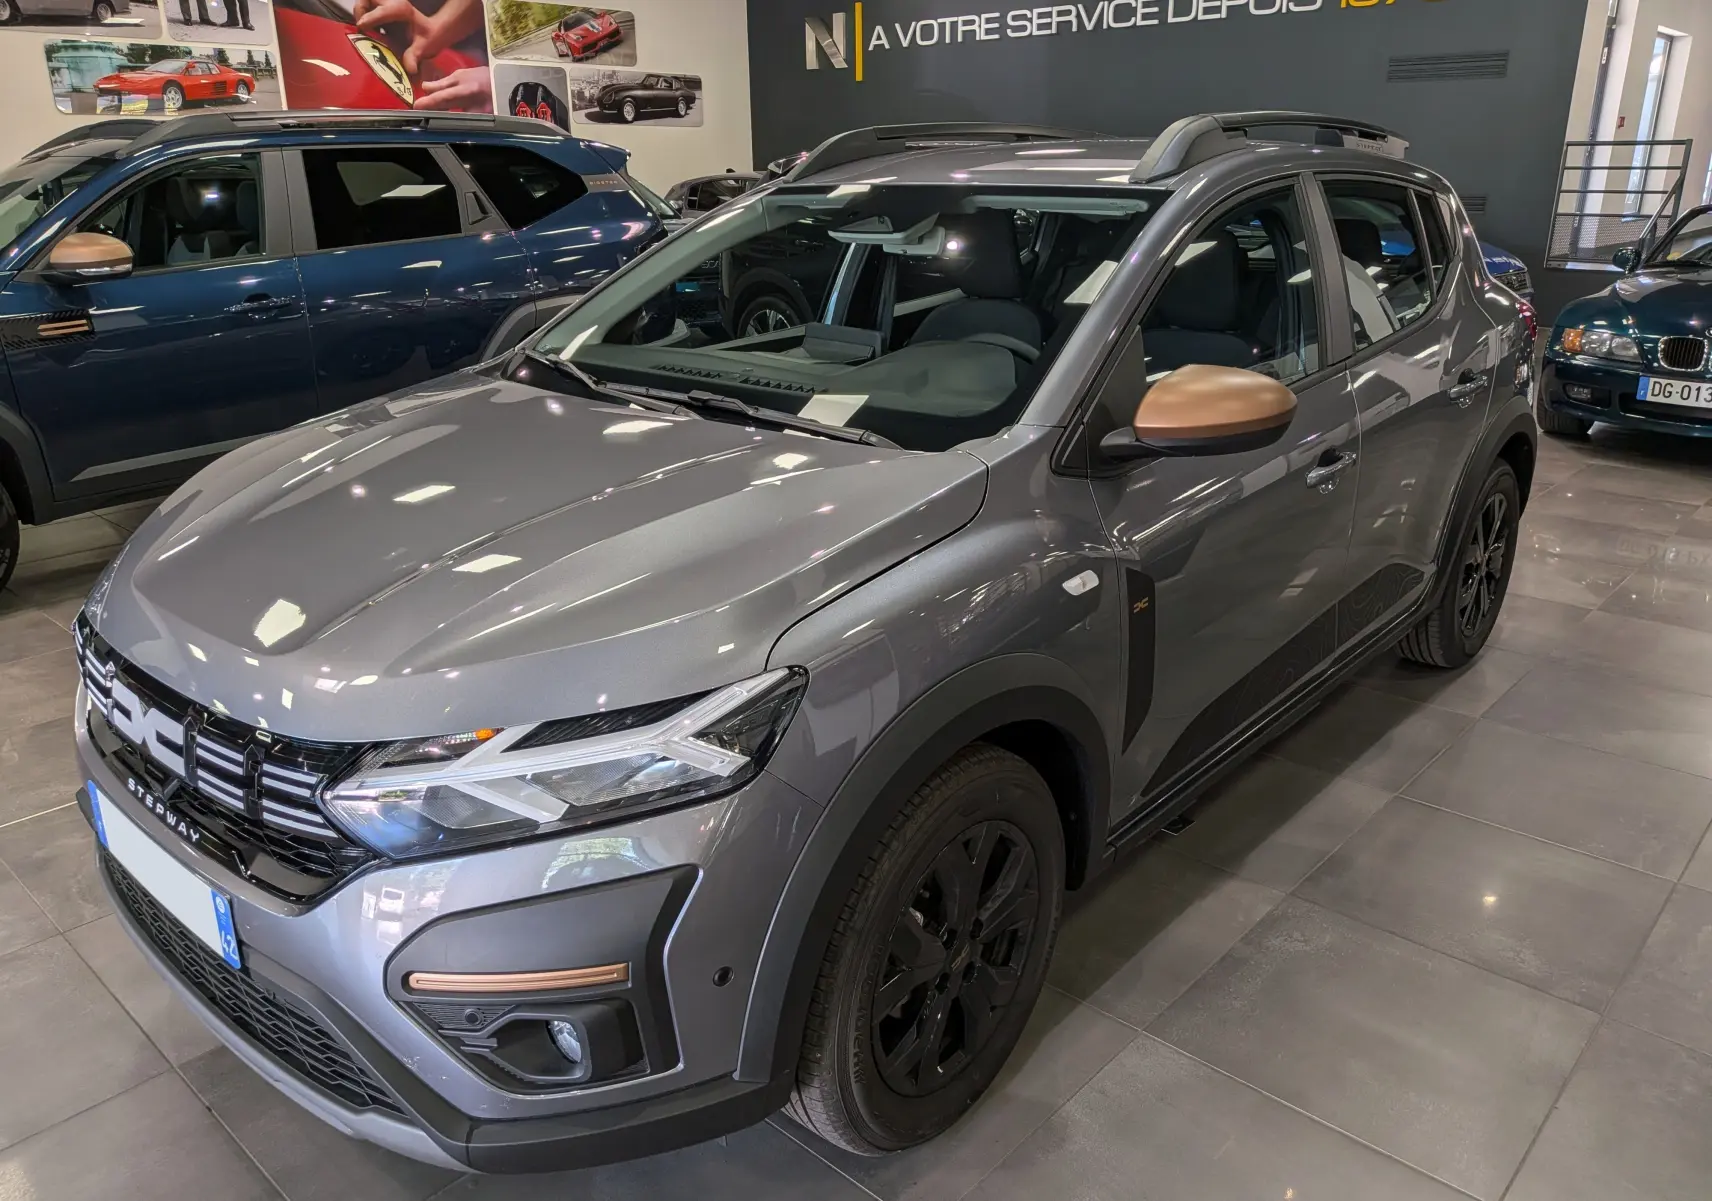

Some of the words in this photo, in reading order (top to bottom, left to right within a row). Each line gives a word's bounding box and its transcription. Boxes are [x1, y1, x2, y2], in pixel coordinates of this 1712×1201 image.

[804, 12, 848, 70] N
[868, 25, 890, 51] A
[894, 12, 1000, 48] VOTRE
[1006, 0, 1160, 38] SERVICE
[127, 777, 200, 842] STEPWAY
[221, 930, 239, 960] 42
